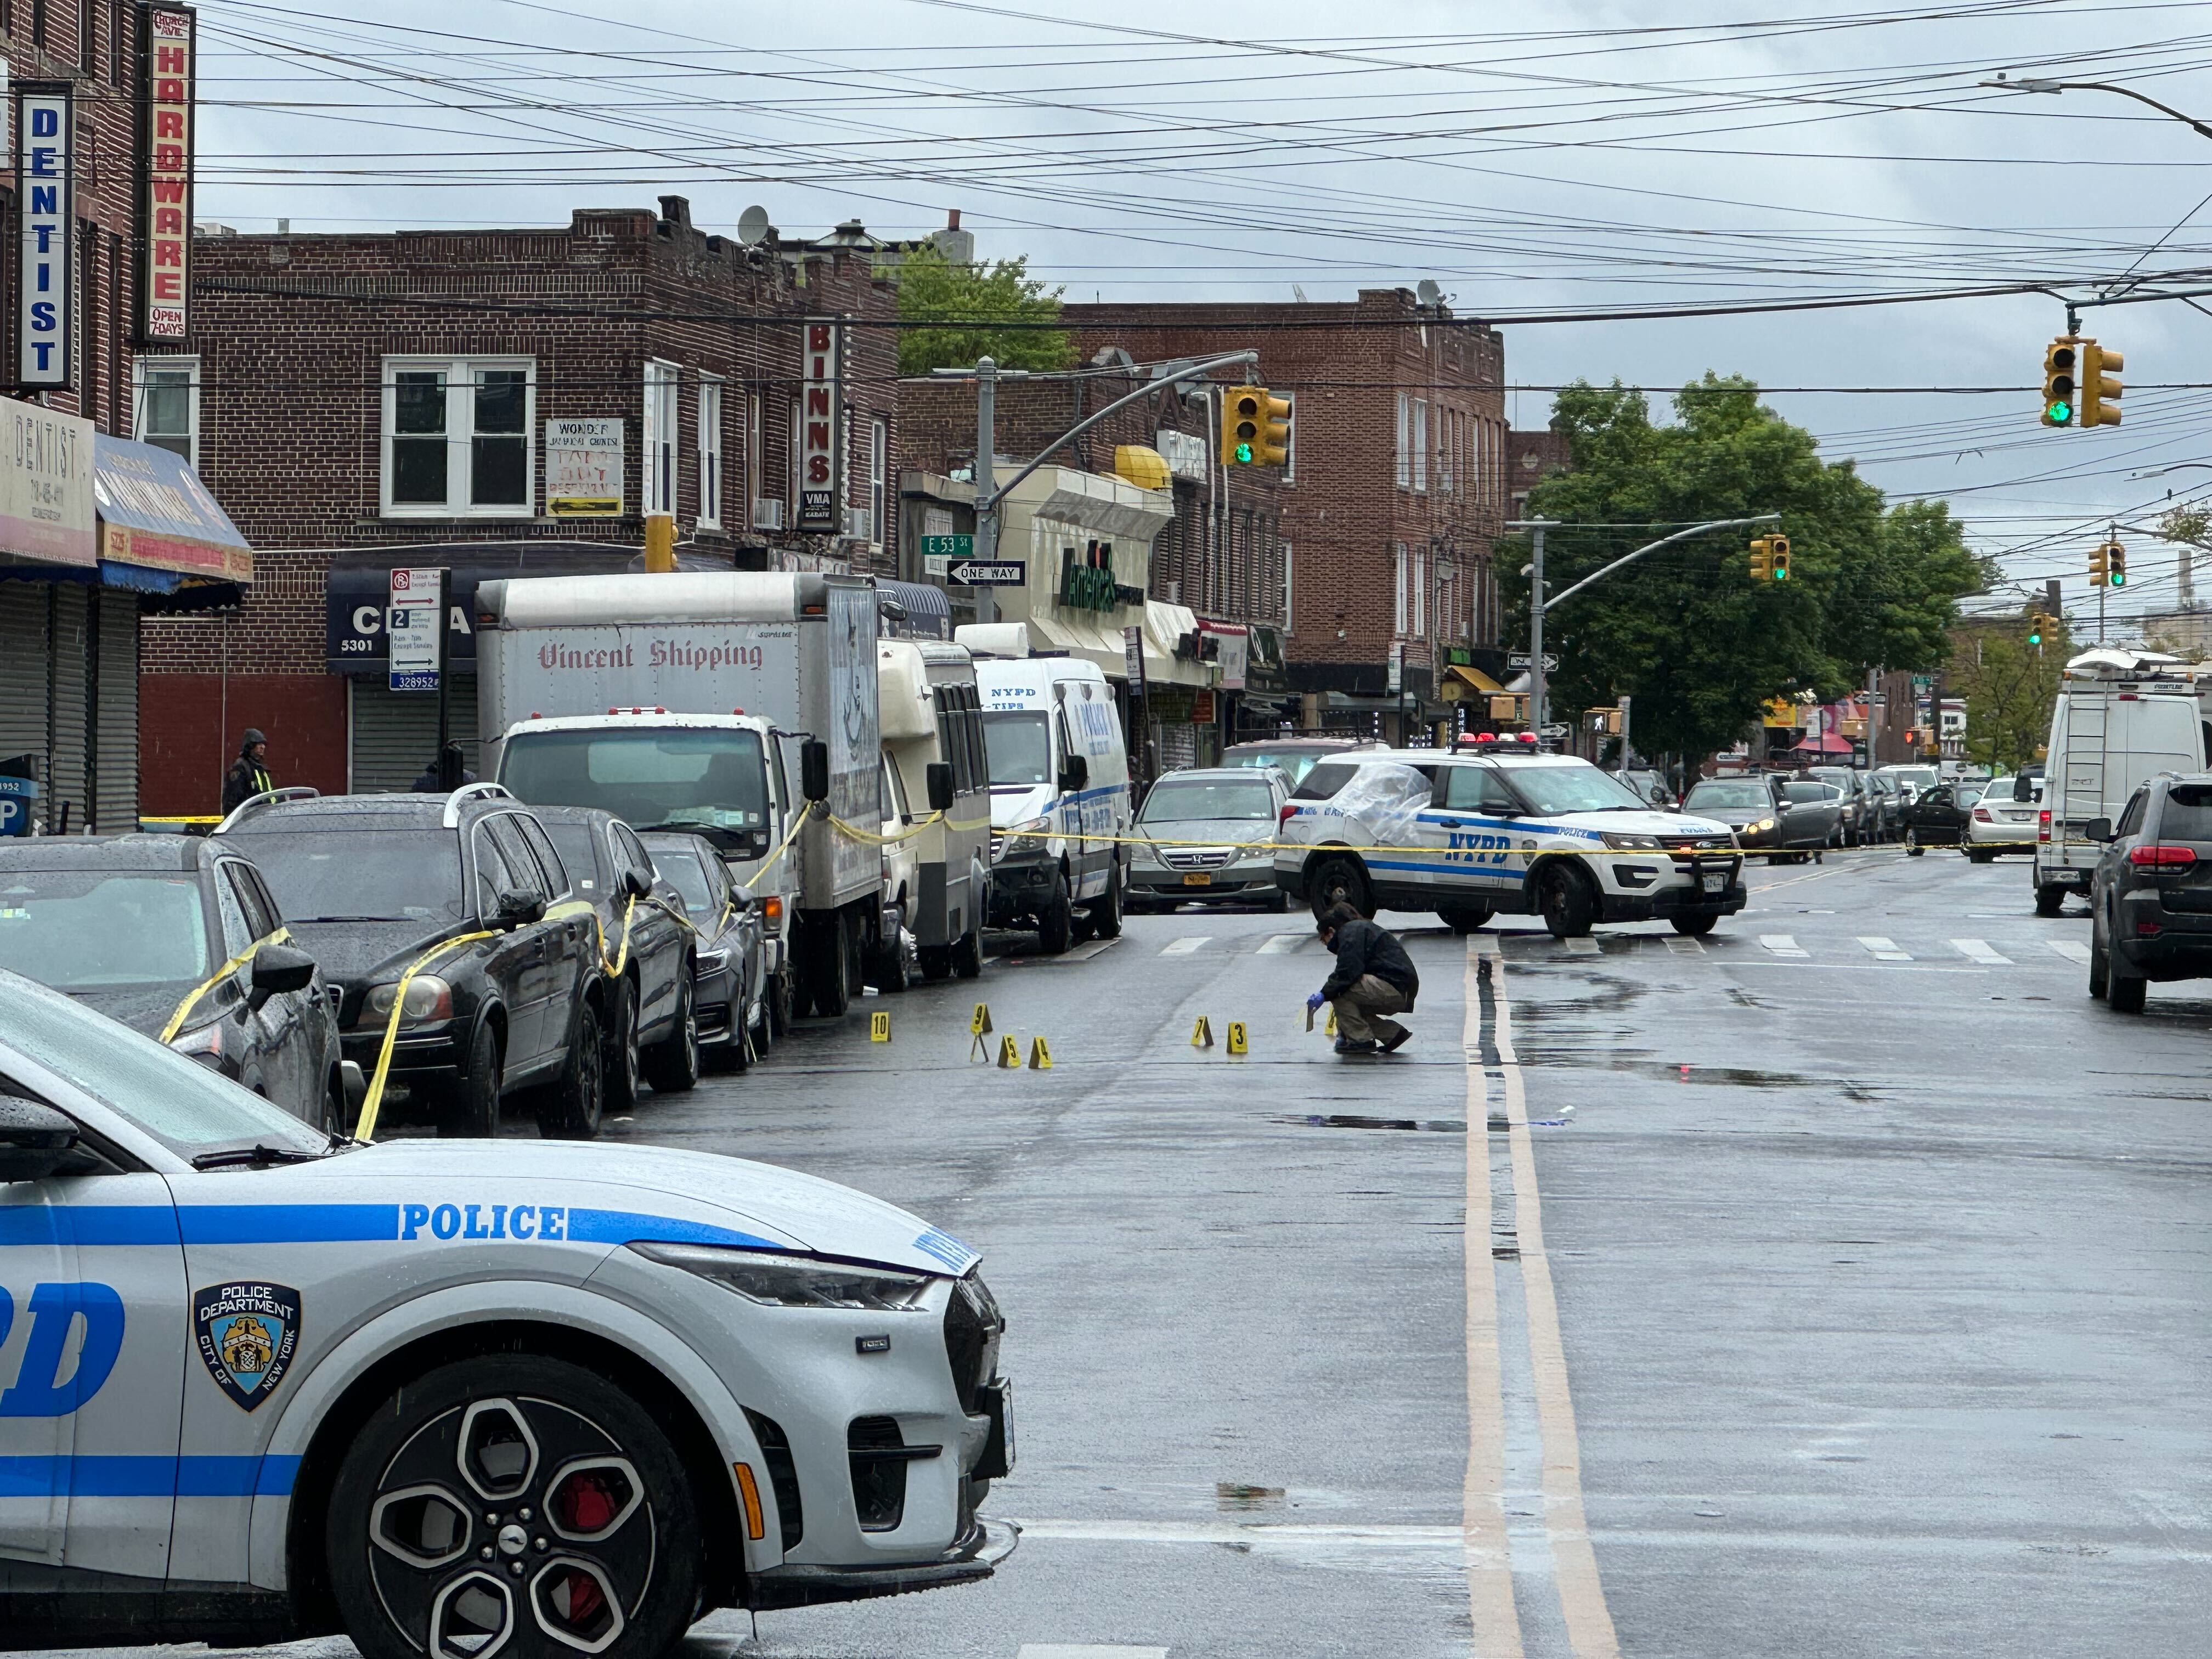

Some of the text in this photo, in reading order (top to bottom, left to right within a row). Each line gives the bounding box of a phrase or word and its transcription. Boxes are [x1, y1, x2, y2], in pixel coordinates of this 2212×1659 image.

[151, 46, 184, 300] HARDWARE
[31, 109, 58, 371] DENTIST
[153, 307, 181, 323] OPEN
[150, 321, 184, 335] 7-DAYS
[809, 325, 830, 483] BINNS
[559, 424, 608, 435] WONDER
[16, 414, 76, 481] DENTIST
[806, 493, 830, 504] VMA
[929, 537, 935, 552] E
[941, 537, 955, 552] 53
[961, 568, 1015, 579] ONE WAY
[395, 610, 404, 627] 2
[341, 640, 373, 651] 5301
[537, 639, 763, 671] Vincent Shipping
[399, 677, 433, 688] 328952
[991, 689, 1036, 697] NYPD
[1445, 833, 1511, 864] NYPD
[874, 1015, 887, 1034] 10
[975, 1005, 983, 1025] 9
[1234, 1024, 1244, 1045] 3
[1007, 1037, 1016, 1058] 5
[402, 1203, 565, 1240] POLICE
[221, 1286, 273, 1300] POLICE
[200, 1298, 294, 1321] DEPARTMENT
[200, 1329, 295, 1391] CITY OF NEW YORK
